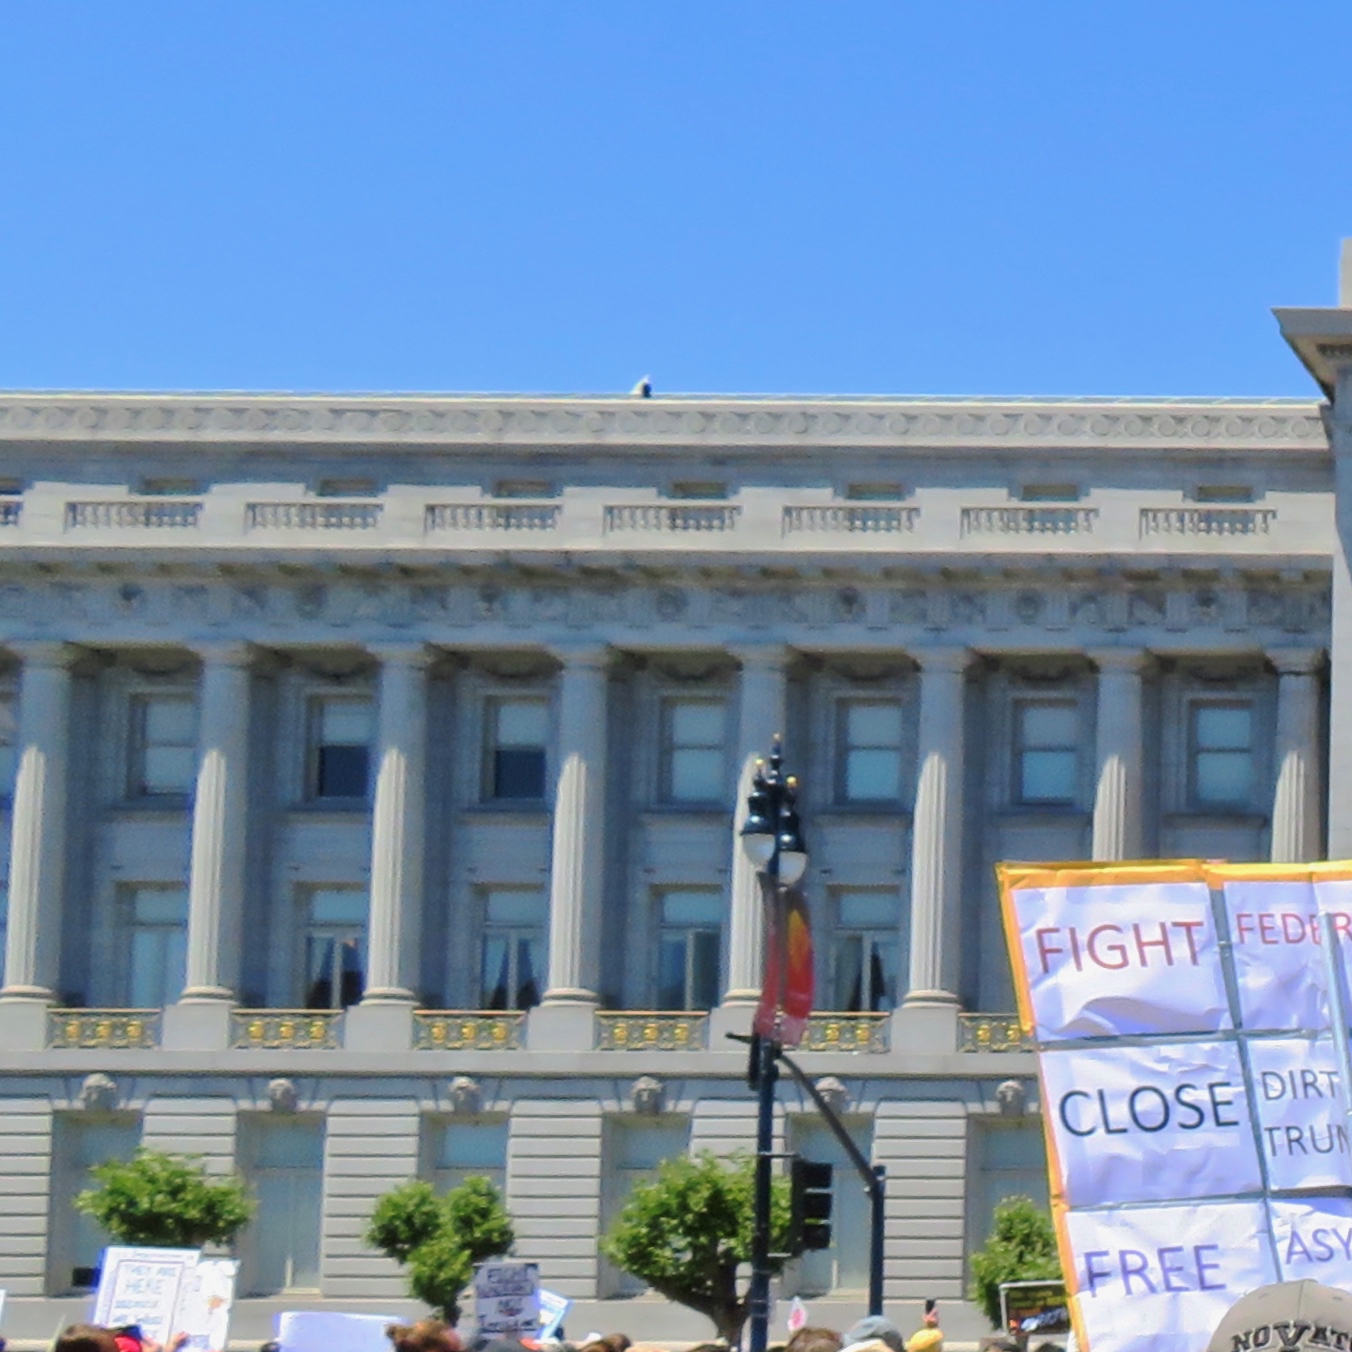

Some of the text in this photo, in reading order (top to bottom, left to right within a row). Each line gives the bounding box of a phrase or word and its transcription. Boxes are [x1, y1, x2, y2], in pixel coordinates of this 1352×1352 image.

[1035, 920, 1204, 974] FIGHT
[1059, 1081, 1240, 1137] CLOSE
[1083, 1243, 1227, 1298] FREE
